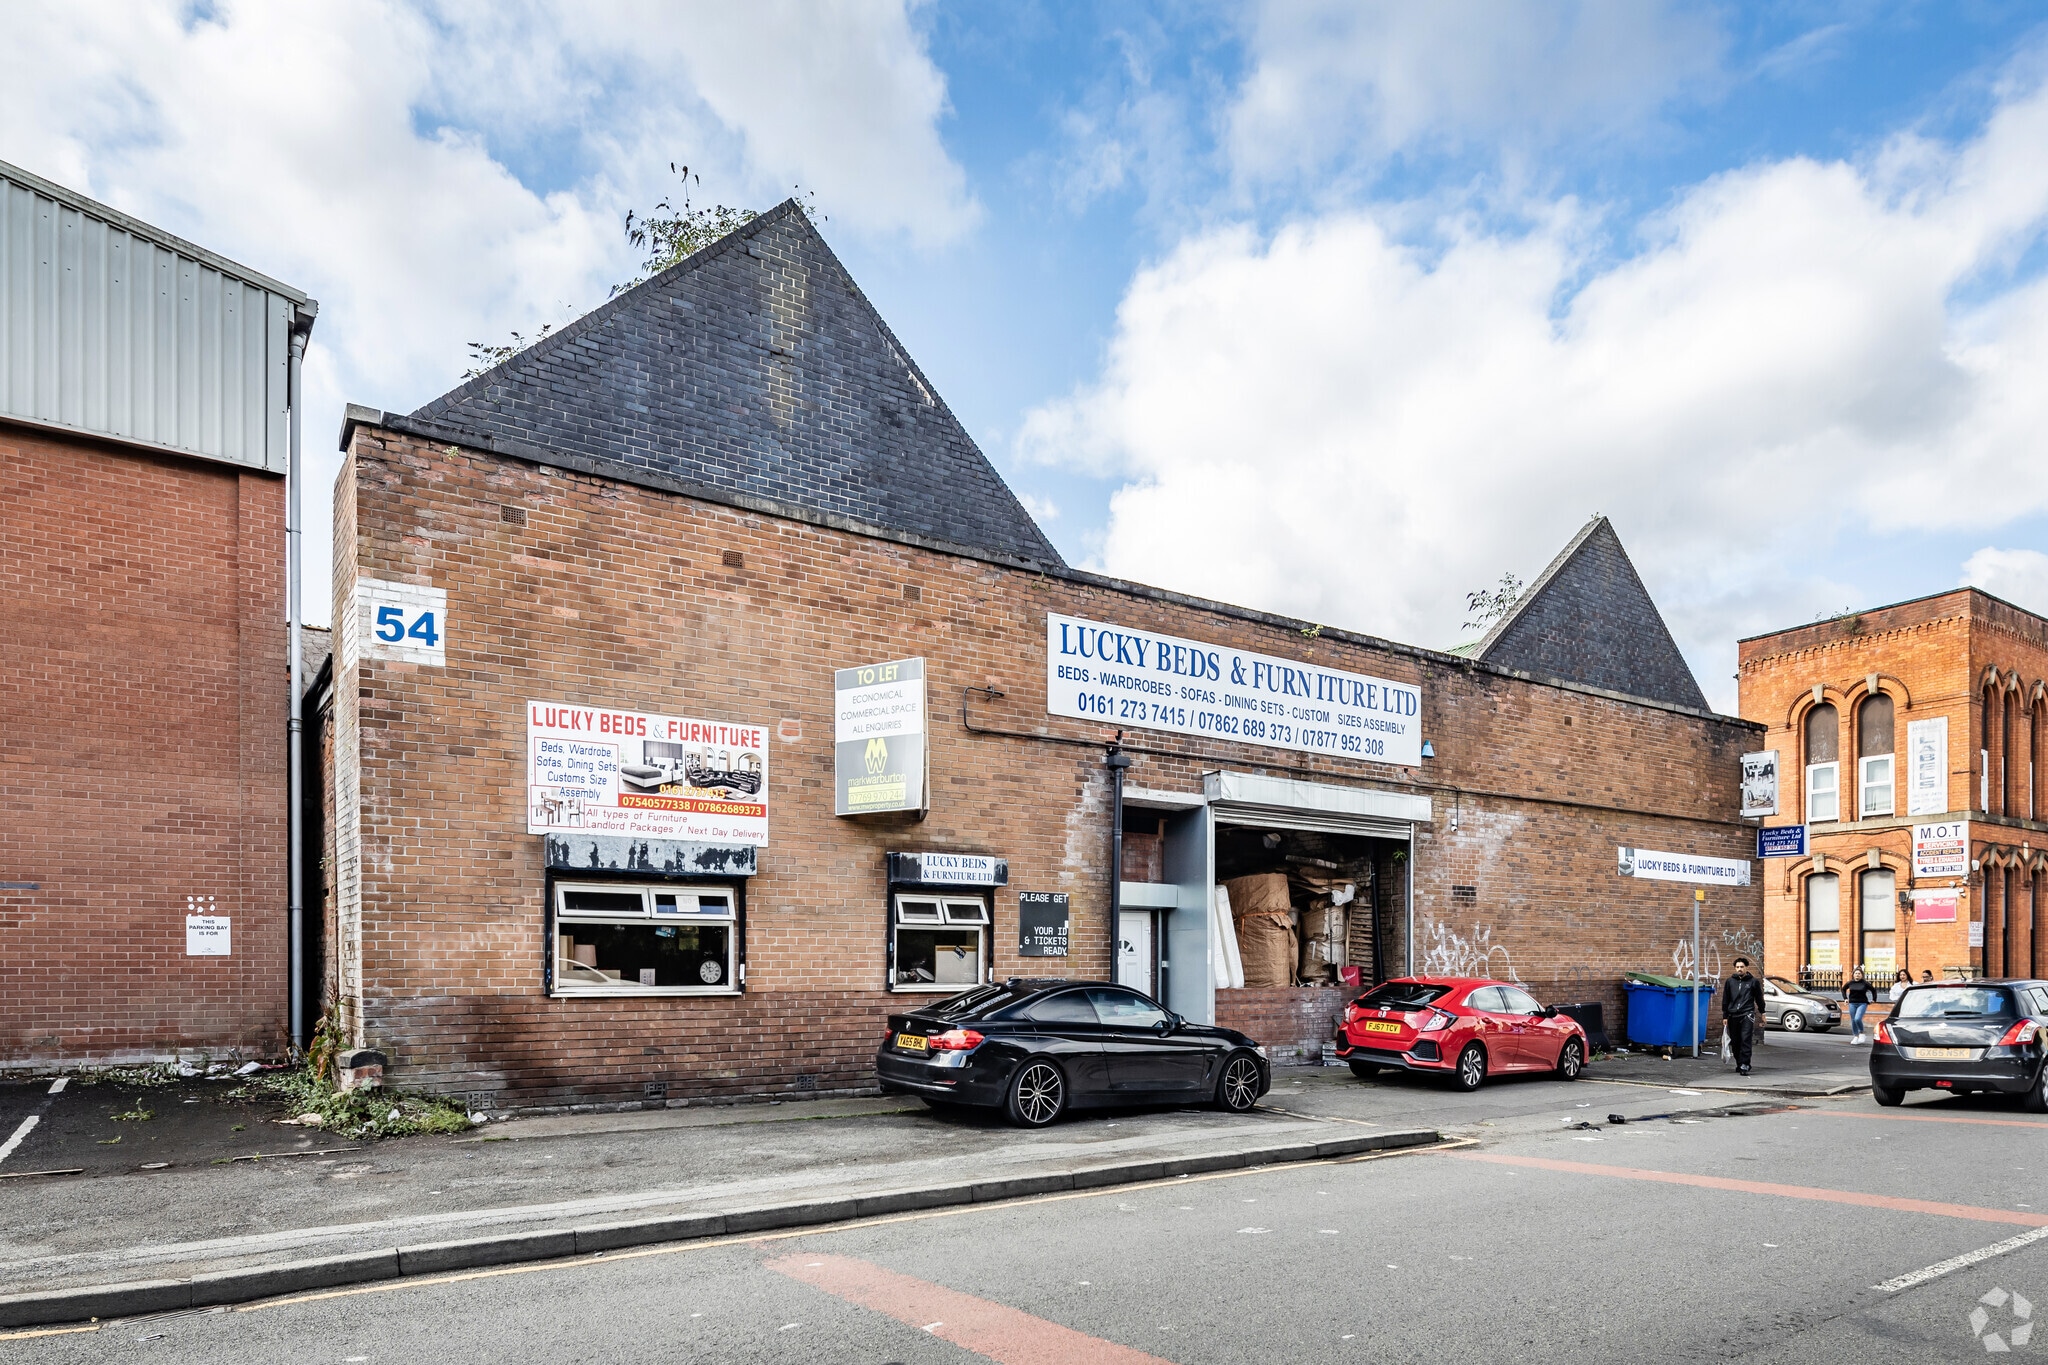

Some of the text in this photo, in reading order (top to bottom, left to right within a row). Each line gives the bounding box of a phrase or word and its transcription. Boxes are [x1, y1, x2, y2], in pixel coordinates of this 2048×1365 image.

[376, 606, 439, 647] 54
[857, 664, 899, 685] TO LET
[1060, 623, 1151, 668] LUCKY
[1156, 641, 1221, 682] BEDS
[1230, 656, 1248, 687] &
[1382, 686, 1417, 717] LTD
[852, 689, 903, 705] ECONOMICAL
[1058, 665, 1090, 682] BEDS
[1100, 671, 1172, 697] WARDROBES
[1180, 686, 1216, 704] SOFAS
[1224, 694, 1258, 711] DINING
[1260, 700, 1284, 717] SETS
[1292, 707, 1330, 723] CUSTOM
[1337, 713, 1362, 728] SIZES
[1363, 718, 1406, 735] ASSEMBLY
[841, 703, 917, 721] COMMERCIAL SPACE
[532, 706, 761, 749] LUCKY BEDS & FURNITURE
[852, 720, 903, 734] ALL ENQUIRIES
[1078, 692, 1384, 756] 0161 273 7415 / 07862 689 373 / 07877 952 308
[541, 741, 613, 758] Beds, Wardrobe,
[536, 756, 617, 773] Sofas, Dining Sets
[547, 771, 608, 786] Customs Size
[848, 772, 907, 787] markwarburton
[559, 786, 601, 802] Assembly
[659, 784, 727, 799] 01612737415
[850, 792, 872, 804] 07769
[873, 791, 888, 802] 970
[622, 796, 691, 812] 07540577338
[698, 801, 763, 817] 07862689373
[586, 808, 688, 823] All types of Furniture
[585, 819, 626, 831] Landlord
[629, 822, 675, 835] Packages
[687, 825, 708, 837] Next
[712, 827, 729, 840] Day
[732, 828, 765, 841] Delivery
[1762, 829, 1779, 837] Lucky
[1919, 847, 1962, 857] ACCIDENT REPAIRS
[1922, 840, 1959, 849] SERVICING
[927, 855, 987, 870] LUCKY BEDS
[1638, 859, 1736, 878] LUCKY BEDS & FURNITURE LTD
[923, 869, 993, 882] & FURNITURE LTD
[1020, 893, 1068, 904] PLEASE GET
[1034, 927, 1068, 936] YOUR ID
[1024, 936, 1068, 946] & TICKETS
[1043, 946, 1068, 956] READY
[1367, 1022, 1398, 1032] FJ67 TCV
[1919, 1048, 1966, 1058] GX65 NSK
